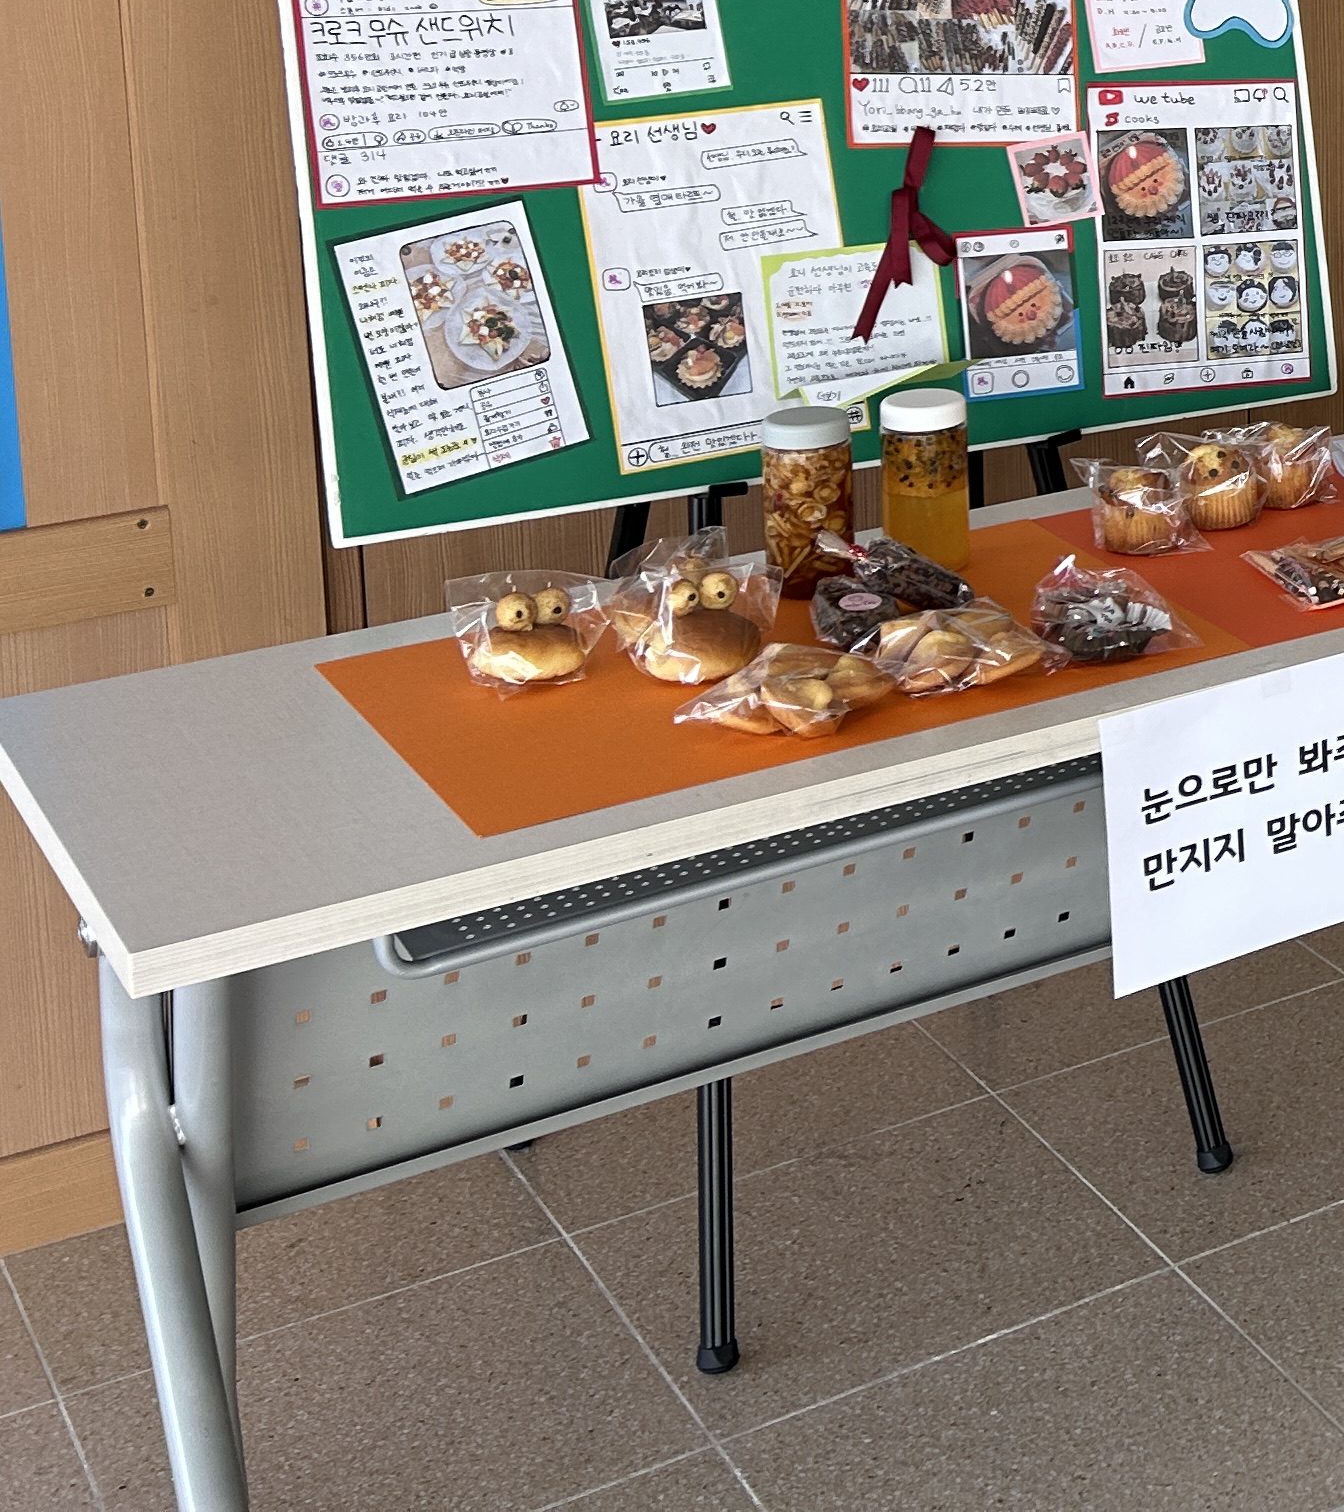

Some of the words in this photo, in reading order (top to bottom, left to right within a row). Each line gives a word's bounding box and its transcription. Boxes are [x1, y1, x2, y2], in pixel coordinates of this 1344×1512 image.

[415, 13, 515, 45] 샌드위치
[871, 78, 889, 93] 111
[920, 77, 931, 93] 11
[959, 79, 997, 92] 5.2만
[1133, 93, 1158, 104] we
[1161, 91, 1196, 105] tube
[1124, 114, 1159, 124] cooks
[609, 123, 640, 146] 요리
[647, 120, 698, 145] 선생님
[360, 149, 386, 162] 314
[1141, 753, 1278, 825] 눈으로만
[1143, 828, 1245, 891] 만지지
